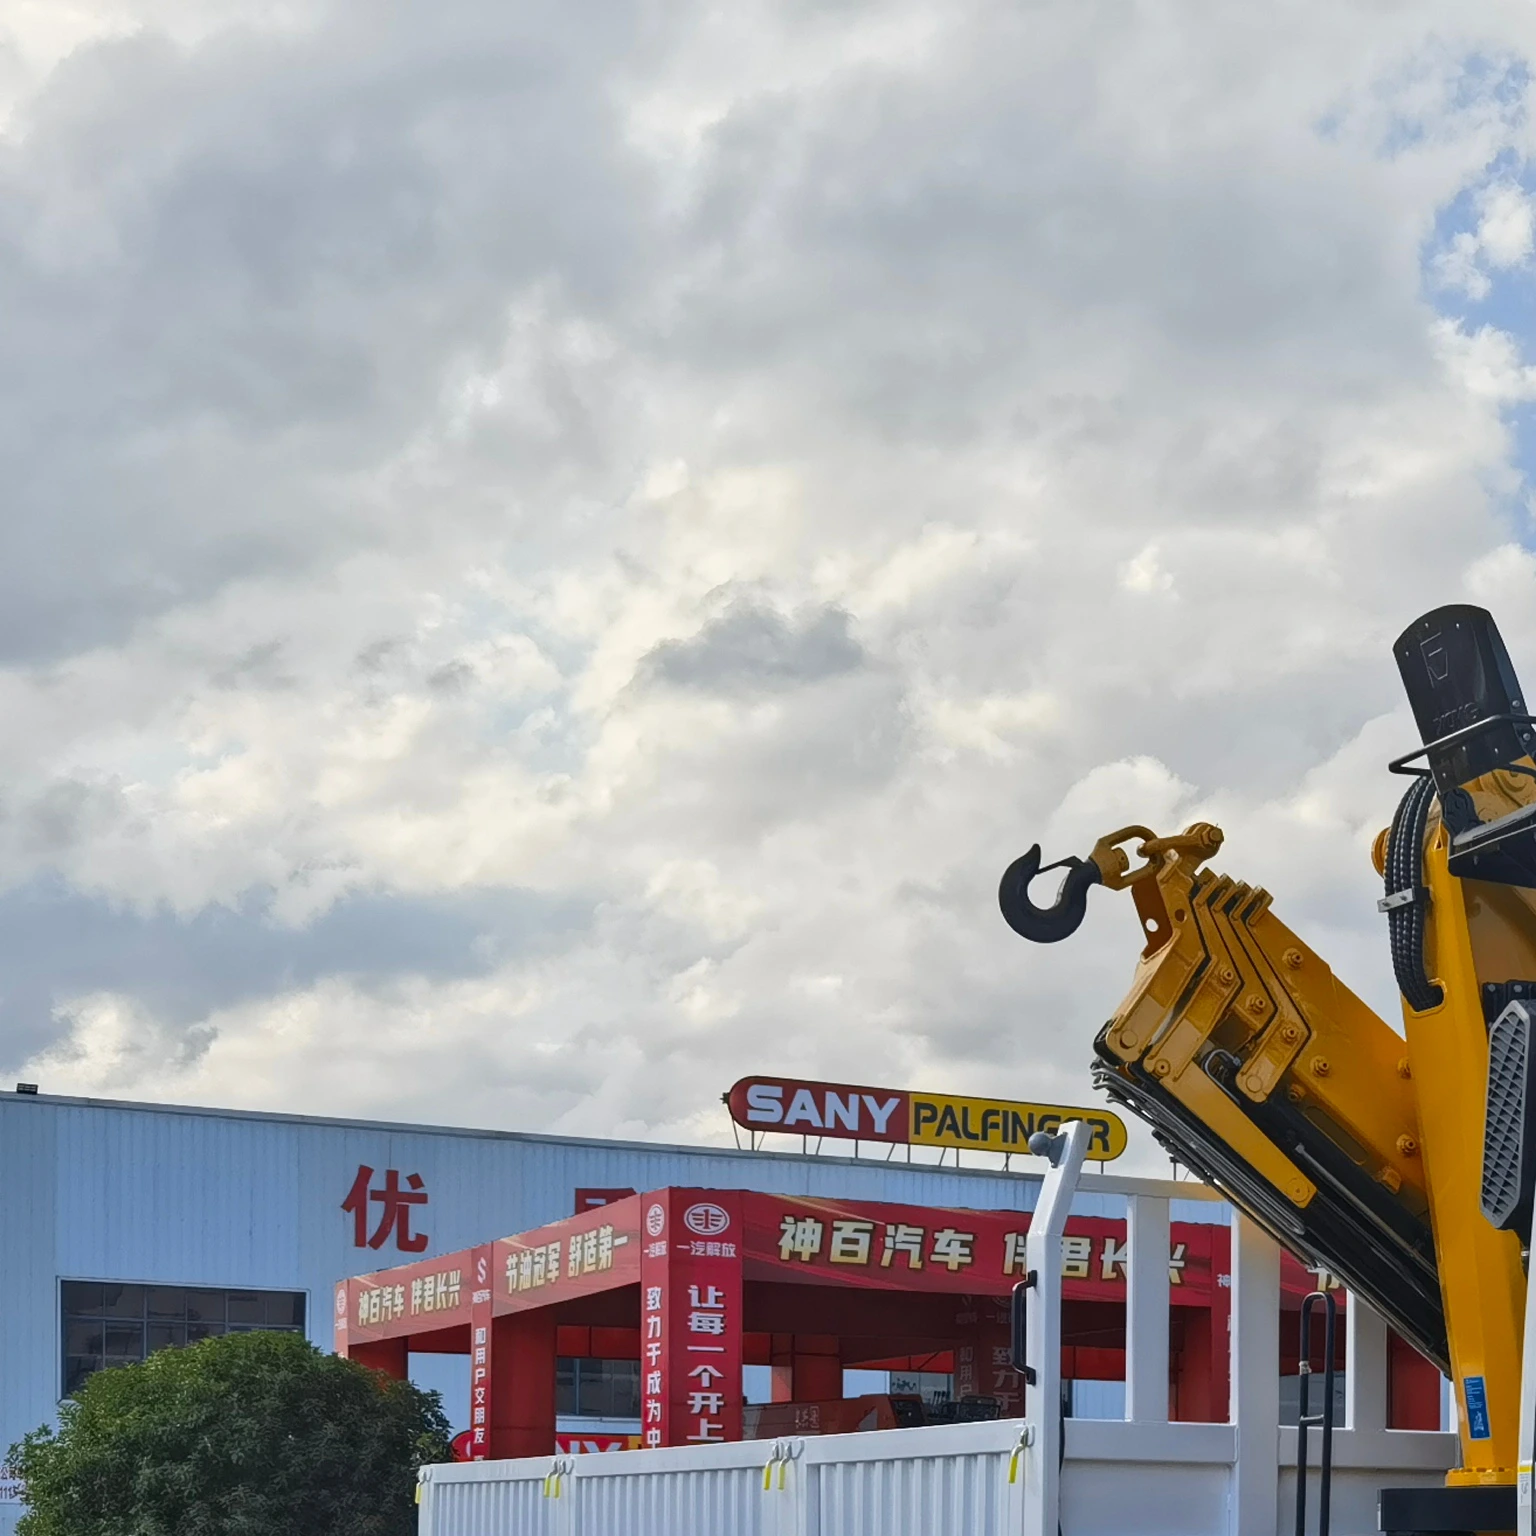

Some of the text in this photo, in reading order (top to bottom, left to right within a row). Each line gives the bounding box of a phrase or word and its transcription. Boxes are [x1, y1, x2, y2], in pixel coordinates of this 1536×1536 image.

[746, 1083, 1110, 1152] SANY PALFINGR
[341, 1165, 428, 1253] 优
[778, 1215, 974, 1271] 神百汽车
[505, 1224, 628, 1294] 节油冠军 舒适第一
[676, 1241, 736, 1258] 一汽解放
[687, 1285, 724, 1441] 让每一个开上
